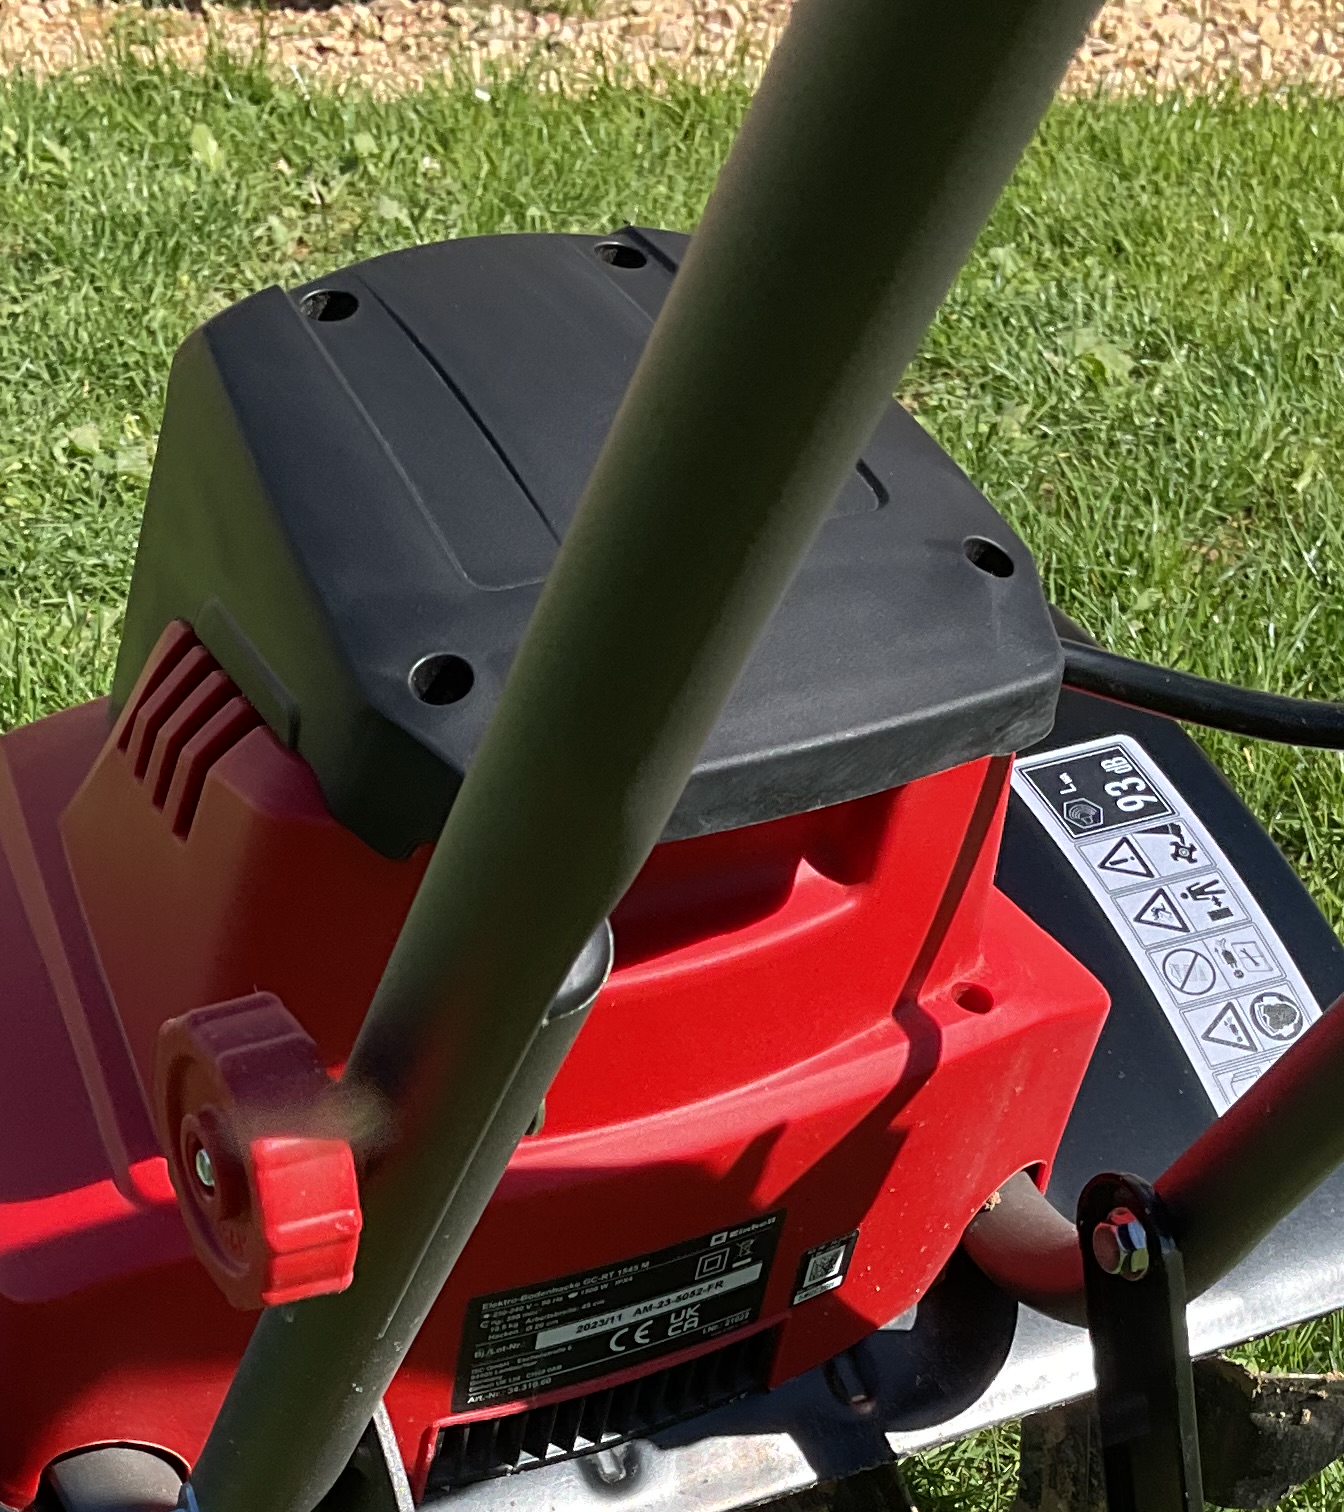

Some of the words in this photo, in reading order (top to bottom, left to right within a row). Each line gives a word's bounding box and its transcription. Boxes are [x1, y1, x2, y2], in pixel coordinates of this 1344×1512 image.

[1100, 756, 1133, 774] dB
[1105, 776, 1158, 812] 93
[729, 1217, 776, 1238] Einhell
[583, 1272, 614, 1286] GC-RT
[639, 1261, 650, 1272] M
[576, 1313, 623, 1334] 2023/11
[632, 1280, 724, 1317] AM-23-5052-FR
[670, 1304, 701, 1324] UK
[610, 1320, 654, 1352] CE
[668, 1317, 700, 1337] CA
